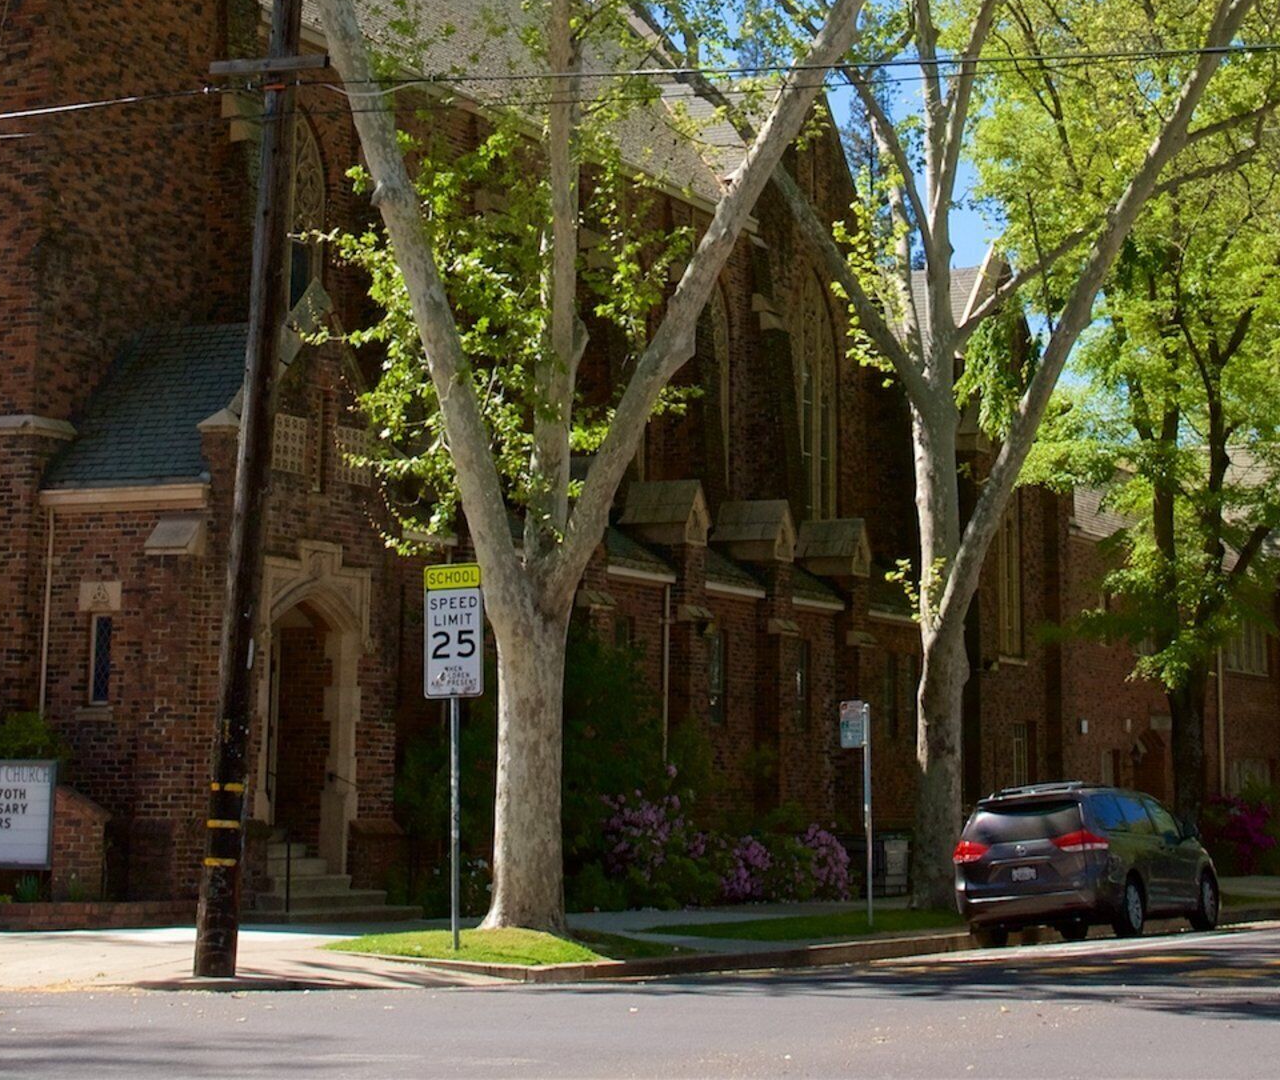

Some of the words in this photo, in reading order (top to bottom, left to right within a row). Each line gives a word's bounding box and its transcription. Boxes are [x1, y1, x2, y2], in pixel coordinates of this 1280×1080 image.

[428, 570, 478, 585] SCHOOL
[430, 596, 477, 610] SPEED
[434, 613, 472, 626] LIMIT
[432, 630, 476, 659] 25
[5, 767, 50, 783] CHURCH
